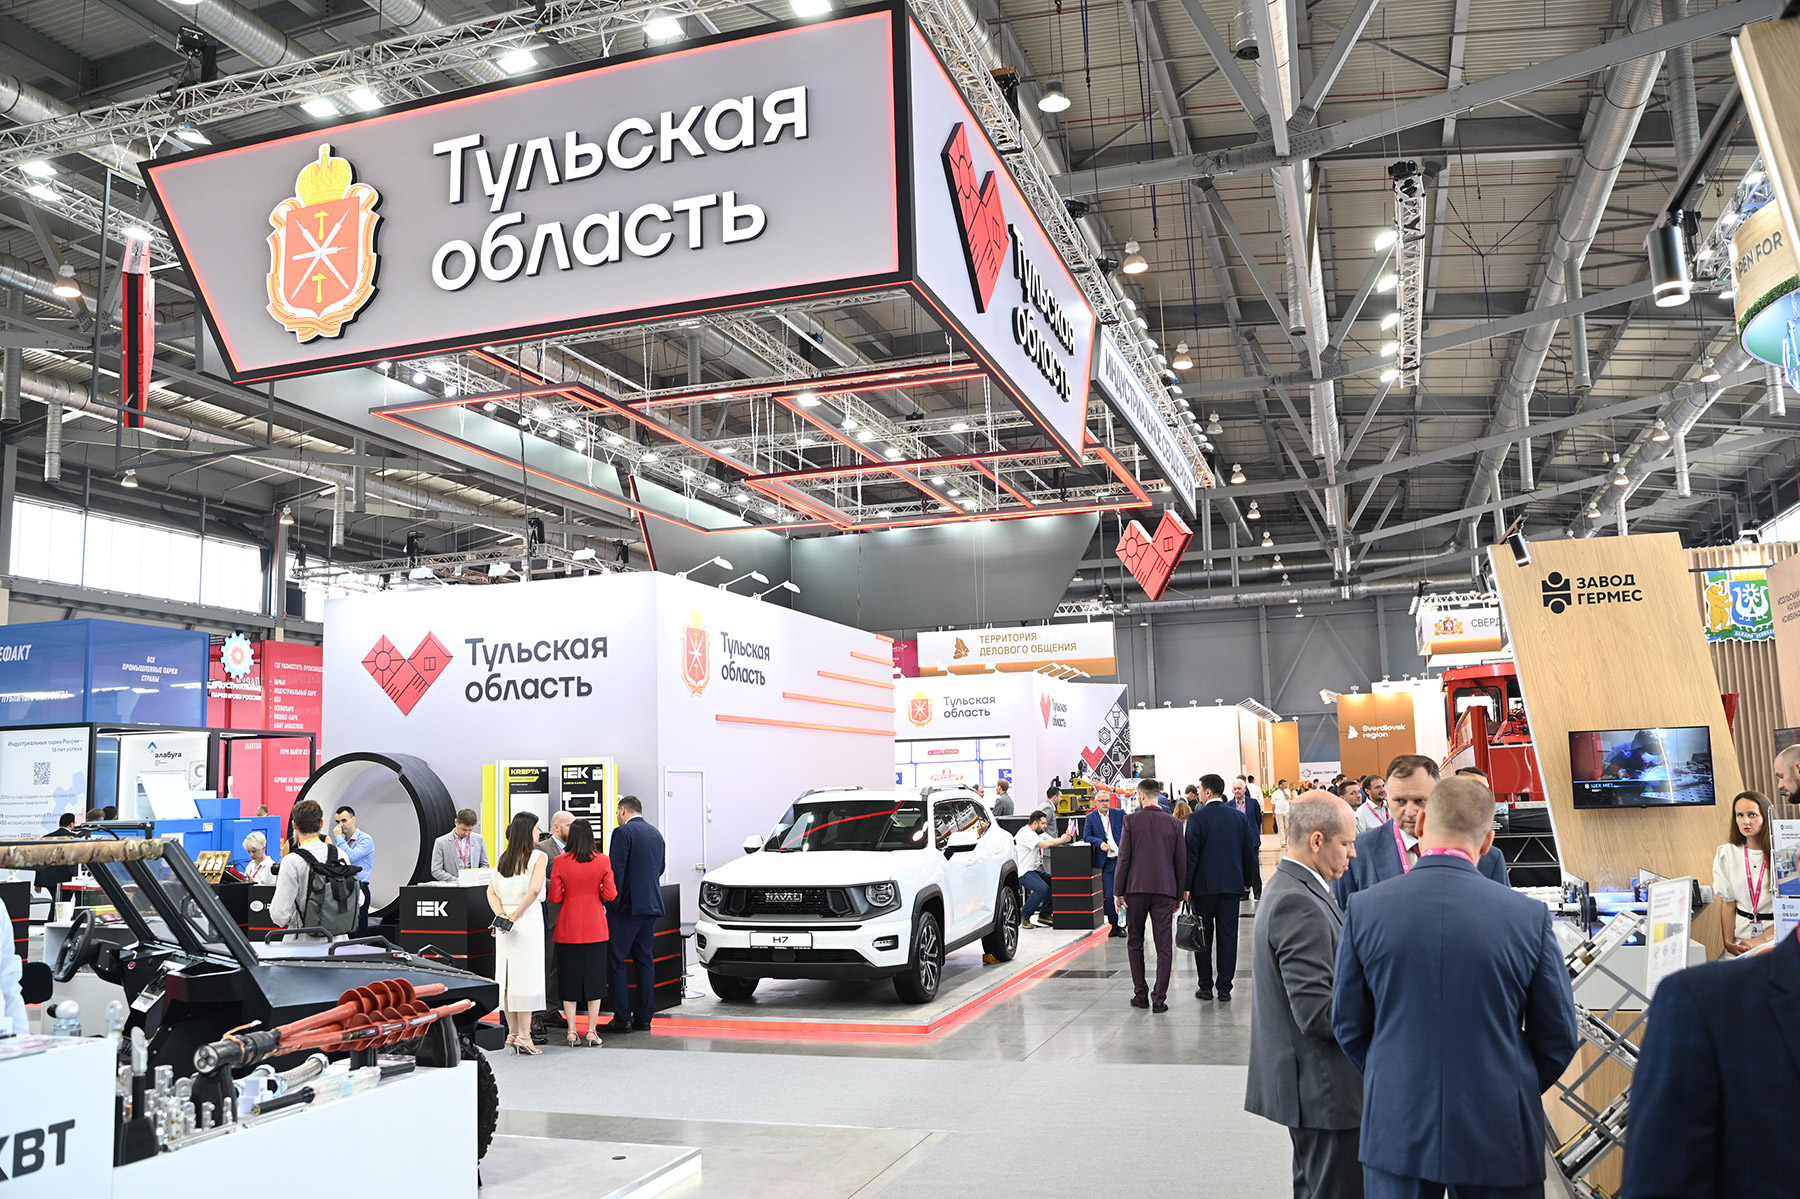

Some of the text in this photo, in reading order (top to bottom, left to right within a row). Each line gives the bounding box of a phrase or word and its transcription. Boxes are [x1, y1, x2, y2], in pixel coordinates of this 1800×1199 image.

[432, 85, 809, 213] Тульская
[431, 190, 767, 291] область
[1755, 230, 1784, 262] FOR
[1009, 223, 1076, 356] Тульская
[1012, 306, 1073, 403] область
[1576, 574, 1636, 589] ЗАВОД
[1577, 589, 1643, 605] ГЕРМЕС
[979, 632, 1038, 644] ТЕРРИТОРИЯ
[720, 631, 770, 661] Тульская
[979, 642, 1077, 657] ДЕЛОВОГО ОБЩЕНИЯ
[464, 636, 608, 672] Тульская
[721, 660, 766, 685] область
[464, 673, 593, 703] область
[943, 696, 996, 707] Тульская
[943, 707, 991, 718] область
[1362, 723, 1406, 731] Sverdlovsk
[1362, 731, 1388, 739] region
[155, 751, 182, 760] алабуга
[765, 892, 803, 902] HAVAL
[772, 936, 789, 944] H7
